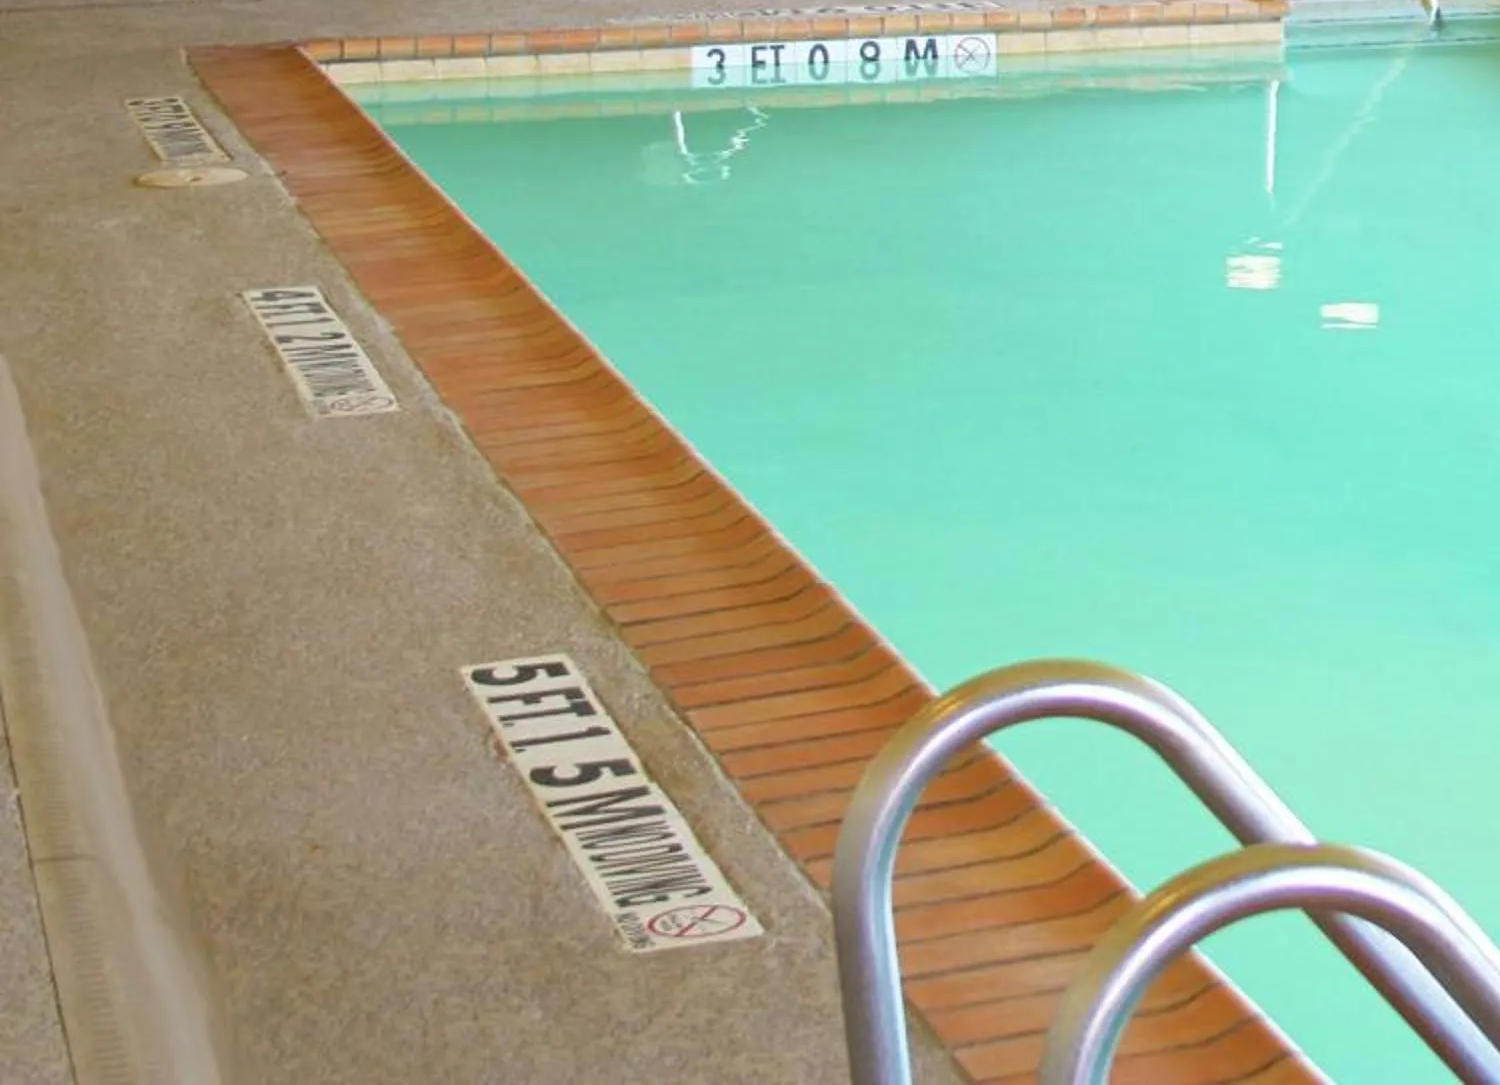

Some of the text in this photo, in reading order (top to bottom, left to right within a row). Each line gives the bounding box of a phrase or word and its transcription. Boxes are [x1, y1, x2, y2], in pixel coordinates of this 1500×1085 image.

[905, 37, 939, 72] M
[250, 290, 316, 302] 4
[274, 331, 346, 344] 2
[281, 343, 359, 363] M
[470, 661, 572, 687] 5
[528, 758, 637, 787] 5
[544, 785, 667, 830] M
[575, 820, 713, 909] NO DIVING
